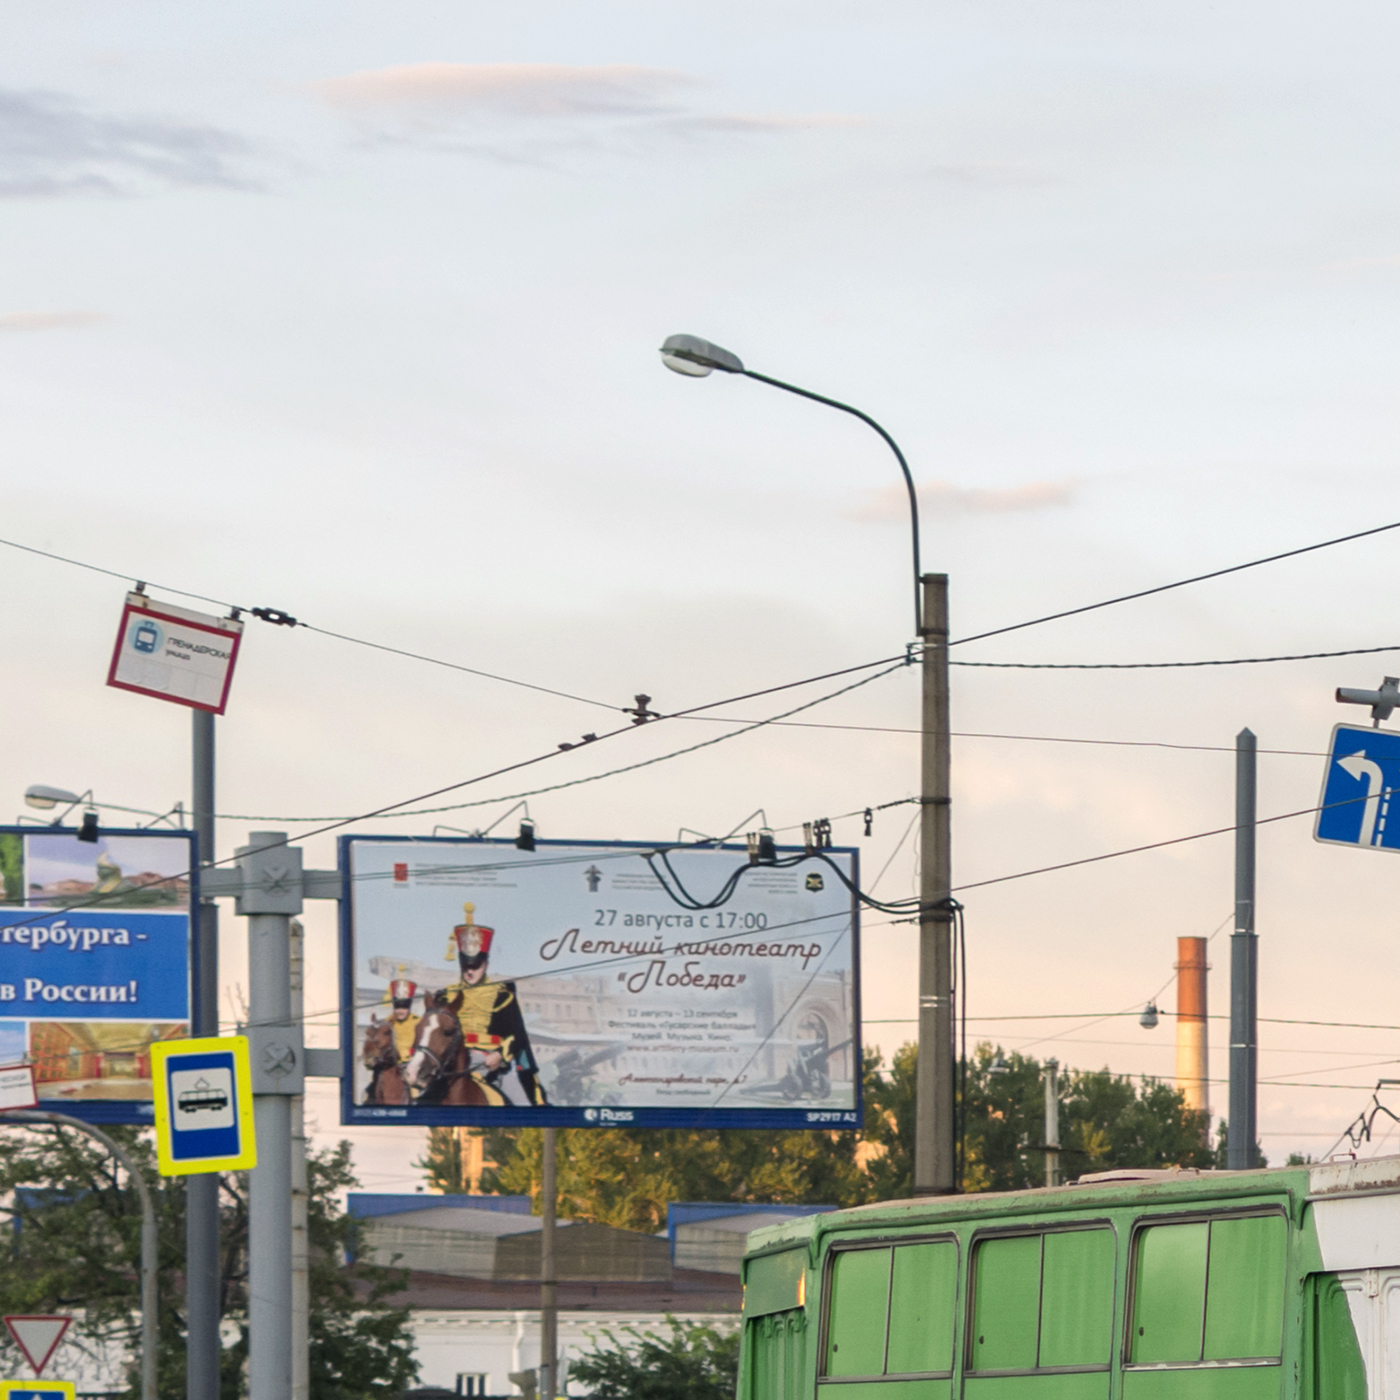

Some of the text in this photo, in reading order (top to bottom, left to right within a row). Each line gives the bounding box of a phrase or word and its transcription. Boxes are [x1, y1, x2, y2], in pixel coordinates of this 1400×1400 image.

[594, 909, 768, 931] 27 августа с 17:00
[539, 928, 822, 971] Летний кинотеатр
[23, 977, 138, 1003] России!
[617, 960, 747, 993] «Победа»
